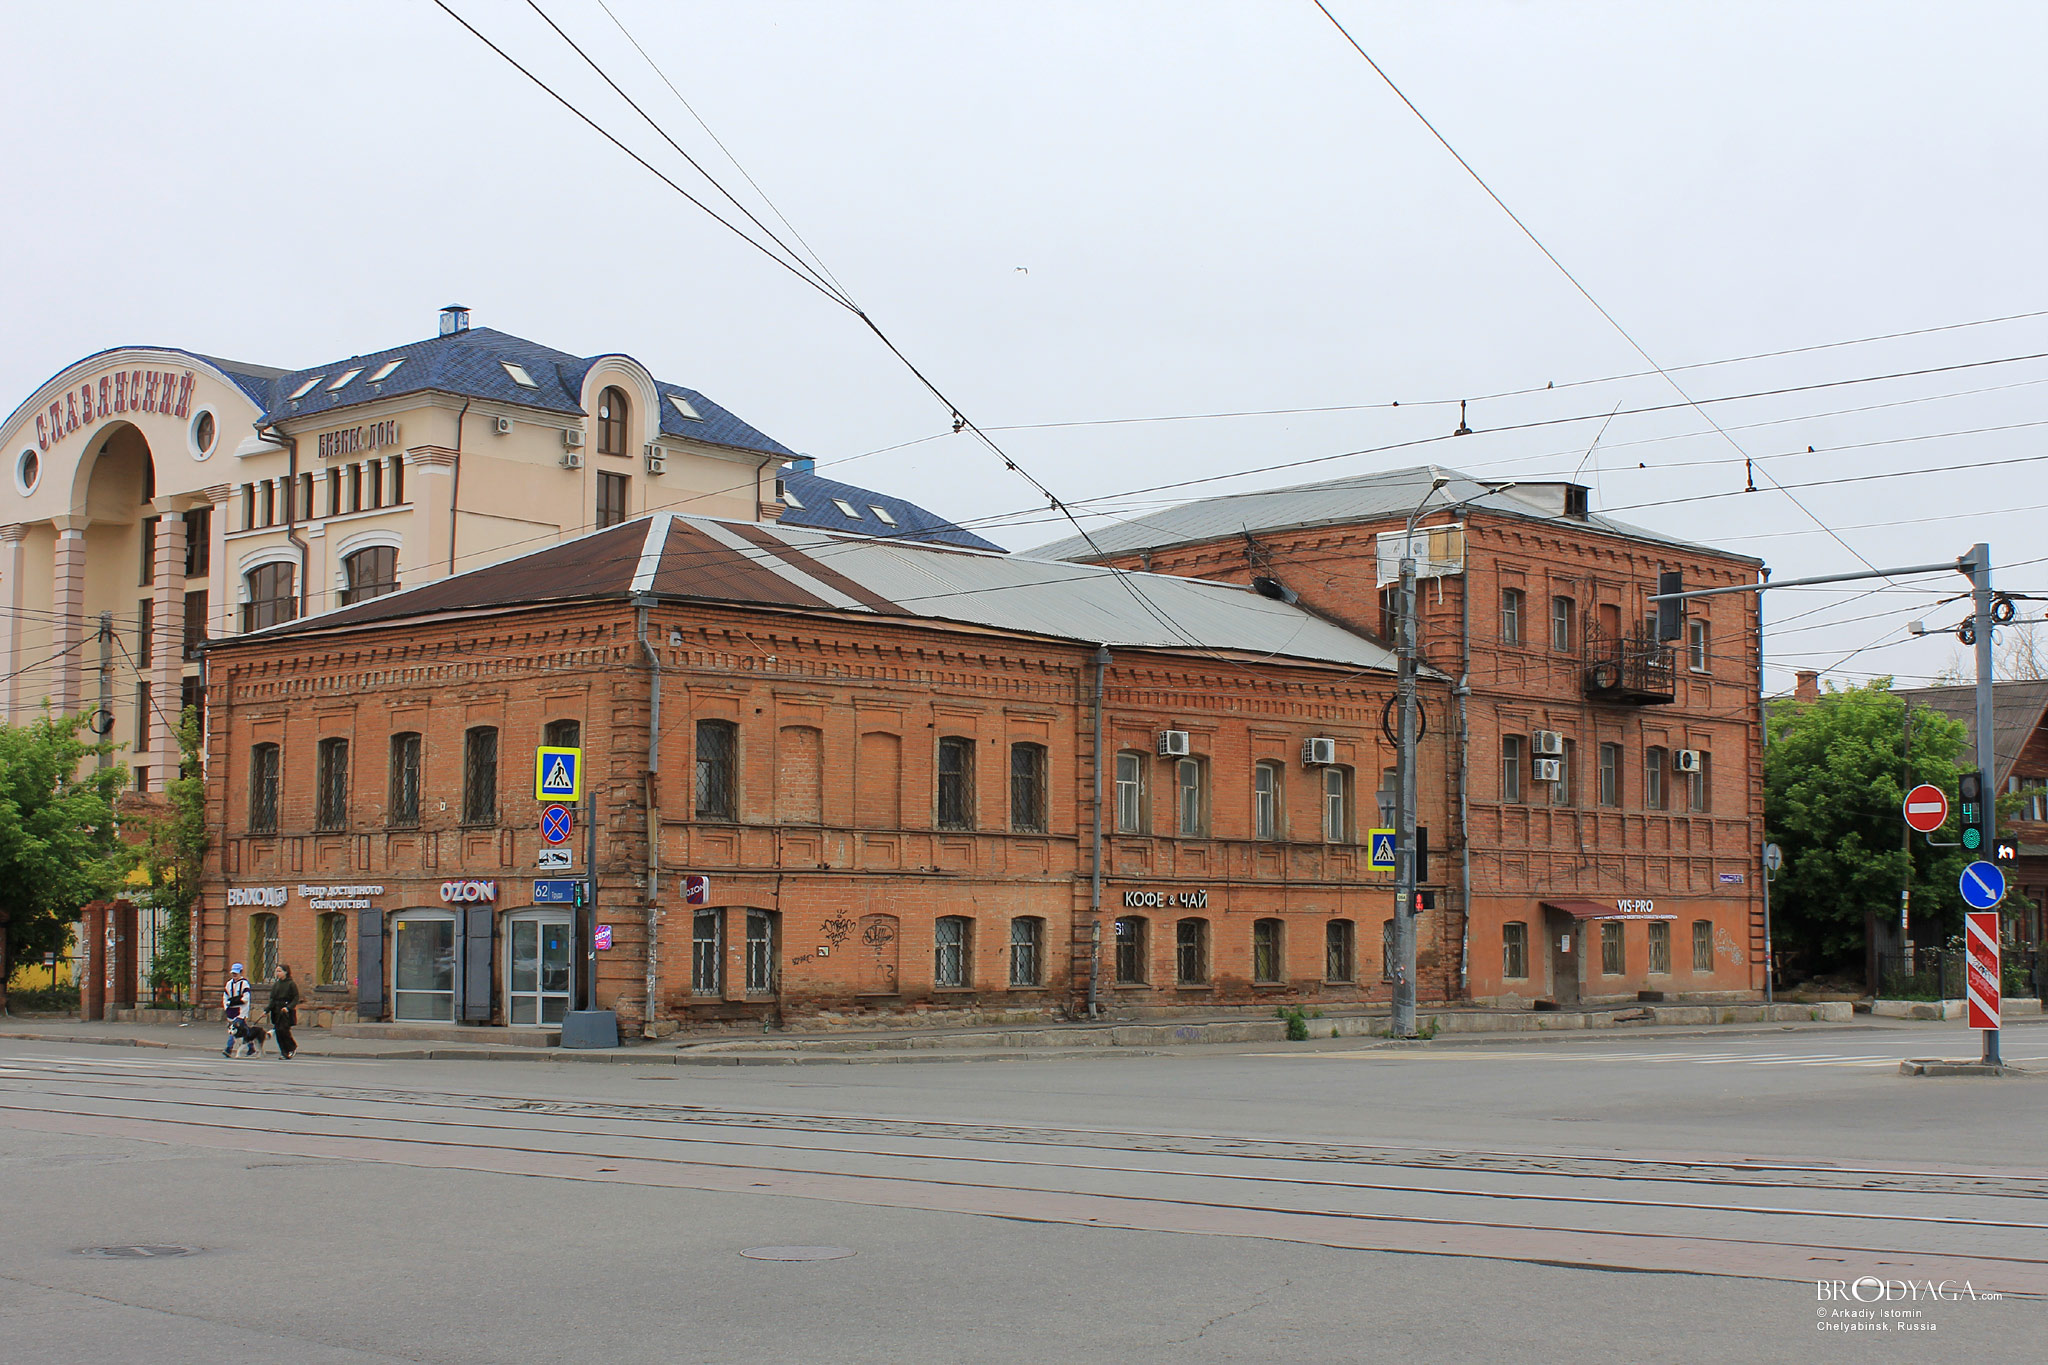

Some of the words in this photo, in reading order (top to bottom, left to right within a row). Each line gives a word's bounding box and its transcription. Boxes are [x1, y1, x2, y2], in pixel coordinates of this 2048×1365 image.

[36, 370, 195, 450] СЛАВЯНСКИЙ
[318, 426, 364, 458] БИЗНЕС
[368, 420, 399, 450] ДОМ
[228, 887, 276, 907] ВЫХОД
[297, 884, 328, 898] Центр
[327, 885, 384, 898] доступного
[440, 881, 497, 902] OZON
[535, 885, 548, 897] 62
[1125, 891, 1164, 908] КОФЕ
[1168, 895, 1176, 906] &
[1180, 889, 1208, 908] ЧАЙ
[310, 898, 371, 911] банкротства
[1617, 899, 1654, 913] VIS-PRO
[594, 929, 611, 941] OZON
